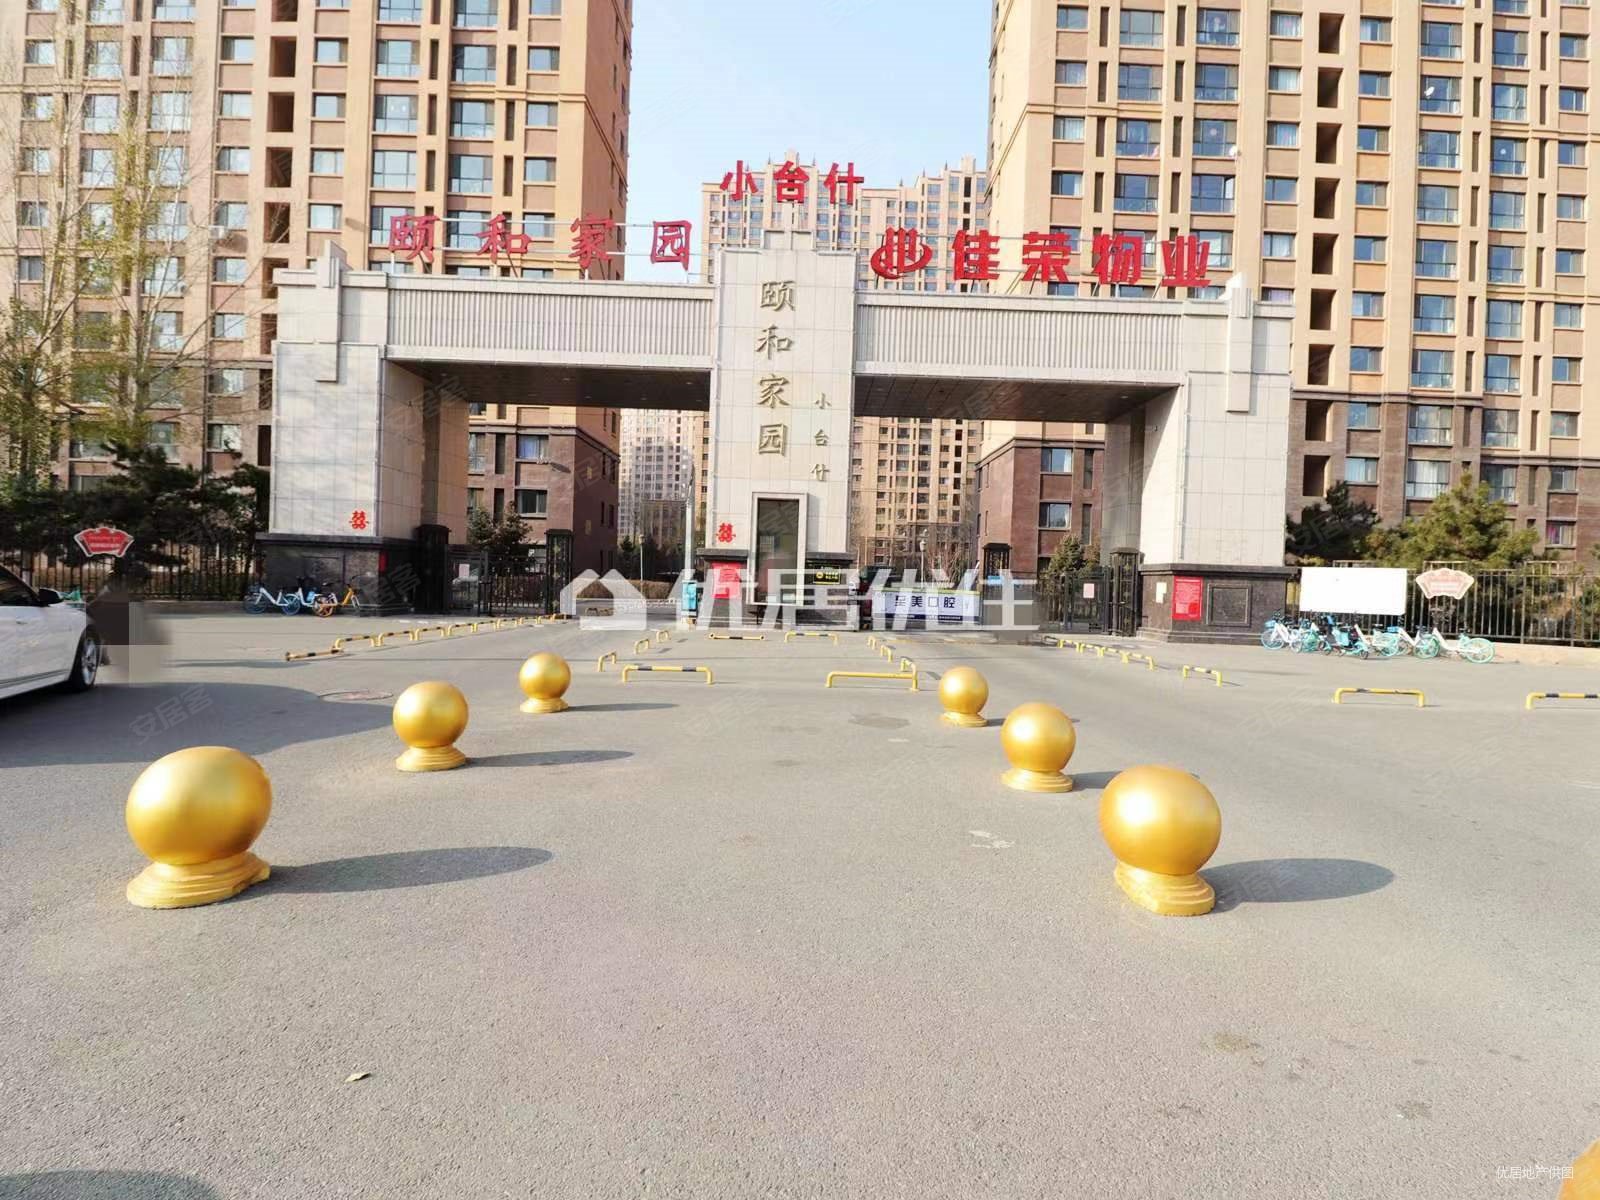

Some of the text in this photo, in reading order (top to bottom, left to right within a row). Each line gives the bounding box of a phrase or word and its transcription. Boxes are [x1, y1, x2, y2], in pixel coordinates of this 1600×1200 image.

[388, 213, 692, 271] 颐和家园
[951, 229, 1211, 288] 佳荣物业
[755, 279, 795, 457] 颐和家园
